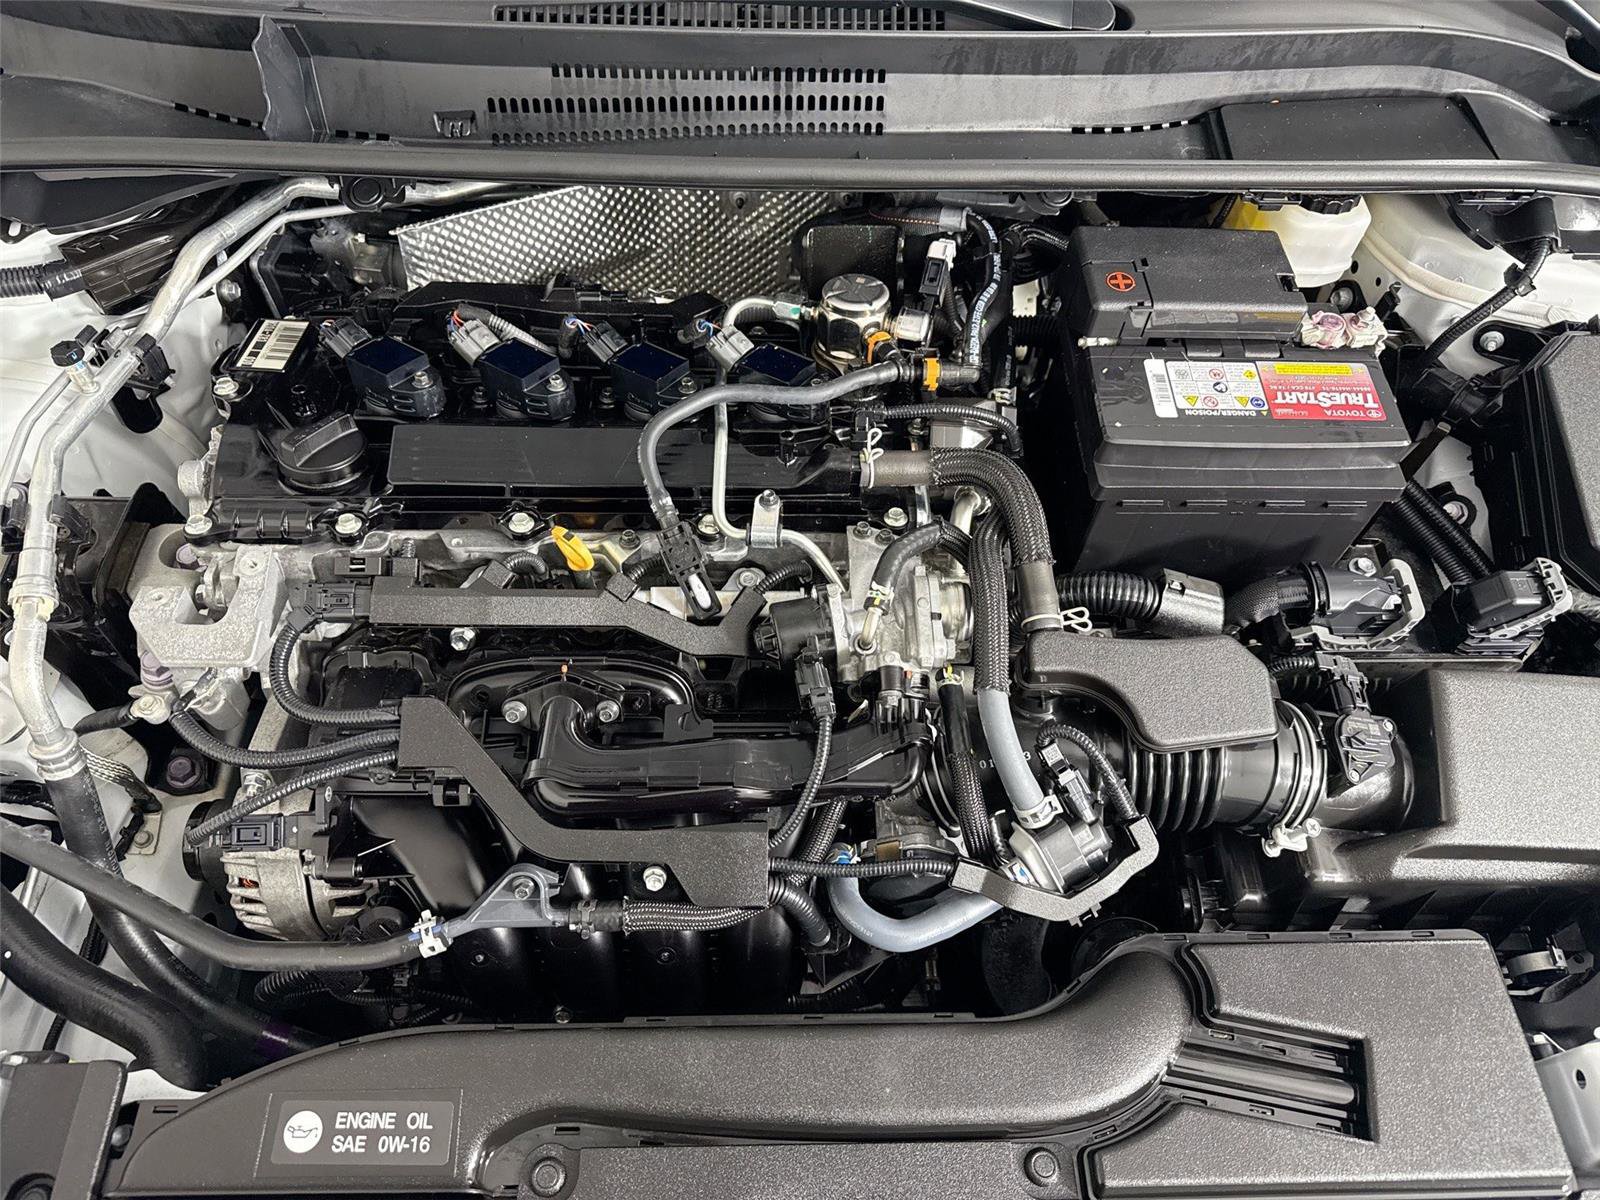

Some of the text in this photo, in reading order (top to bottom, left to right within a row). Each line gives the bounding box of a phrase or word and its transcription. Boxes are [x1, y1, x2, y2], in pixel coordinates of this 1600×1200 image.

[1184, 409, 1257, 418] DANGER/POISON
[1324, 409, 1366, 417] TOYOTA
[335, 1111, 433, 1130] ENGINE OIL
[331, 1135, 431, 1153] SAE 0W-16
